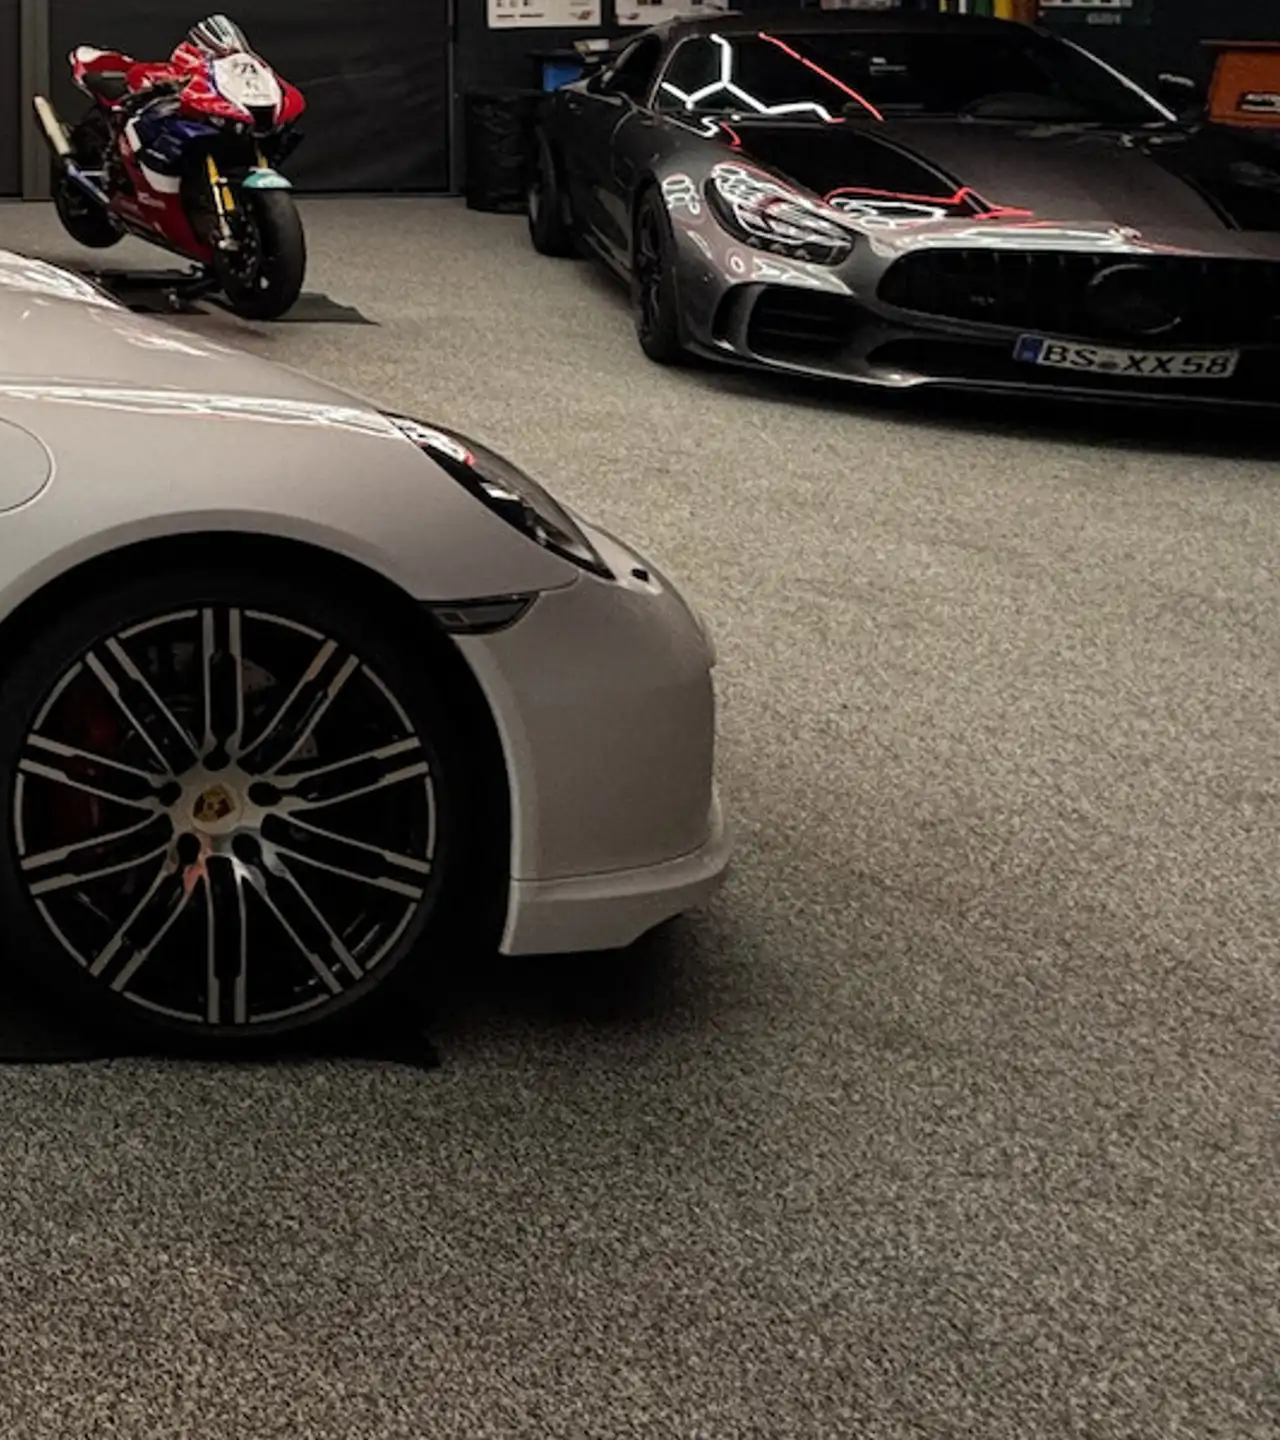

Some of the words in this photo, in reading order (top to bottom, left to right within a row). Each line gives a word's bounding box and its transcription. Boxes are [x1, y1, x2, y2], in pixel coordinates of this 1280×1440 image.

[1042, 344, 1098, 368] BS
[1122, 354, 1178, 375] XX
[1181, 356, 1232, 376] 58
